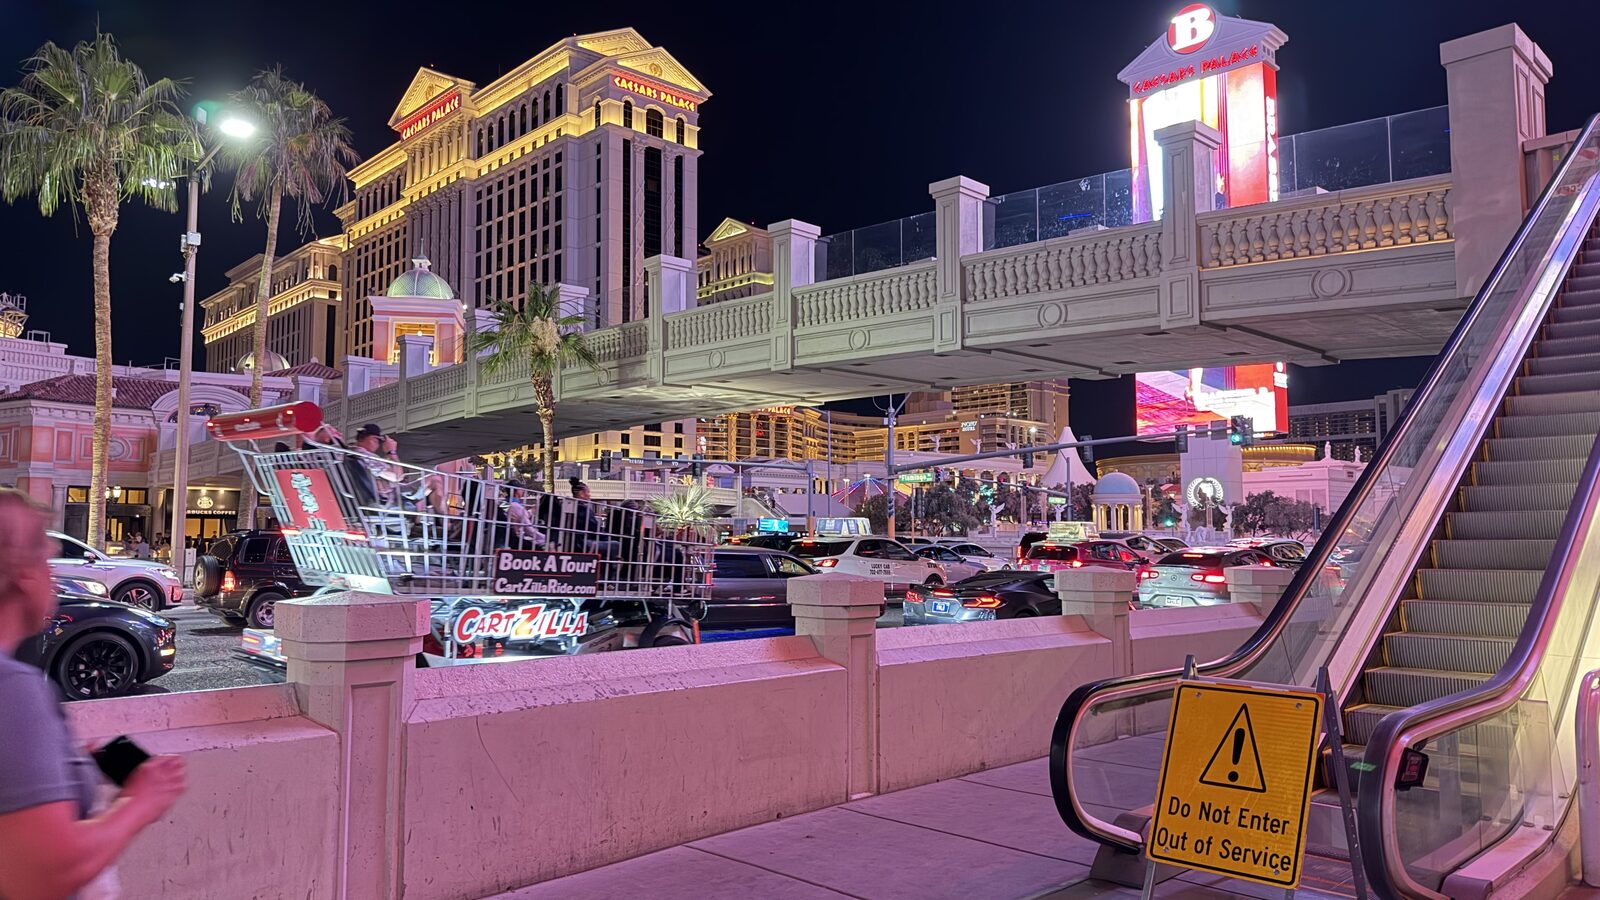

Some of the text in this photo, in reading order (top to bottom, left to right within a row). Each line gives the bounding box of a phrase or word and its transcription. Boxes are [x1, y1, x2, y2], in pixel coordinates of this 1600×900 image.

[1171, 8, 1215, 51] B
[1133, 44, 1258, 93] CAESARS PALACE
[614, 76, 695, 112] CAESARS PALACE
[402, 96, 459, 140] CAESARS PALACE
[499, 552, 597, 574] Book A Tour!
[494, 577, 597, 594] CartZillaRide.com
[1168, 796, 1290, 836] Do Not Enter
[1157, 827, 1292, 871] Out of Service
